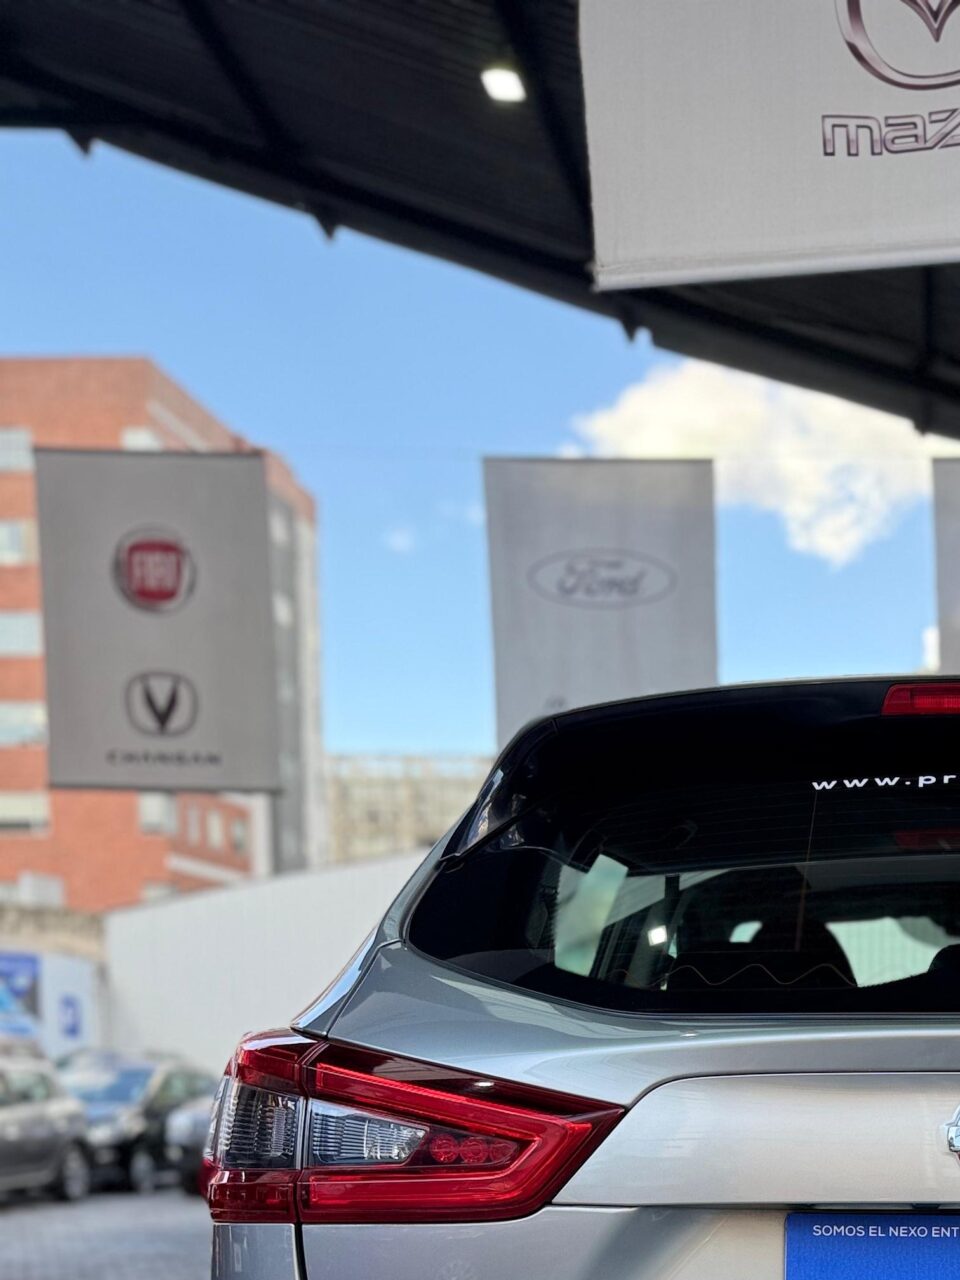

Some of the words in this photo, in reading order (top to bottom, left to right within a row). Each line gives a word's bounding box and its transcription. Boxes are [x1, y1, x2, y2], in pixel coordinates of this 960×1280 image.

[812, 1224, 865, 1237] SOMOS
[868, 1225, 886, 1237] EL
[888, 1226, 928, 1238] NEXO
